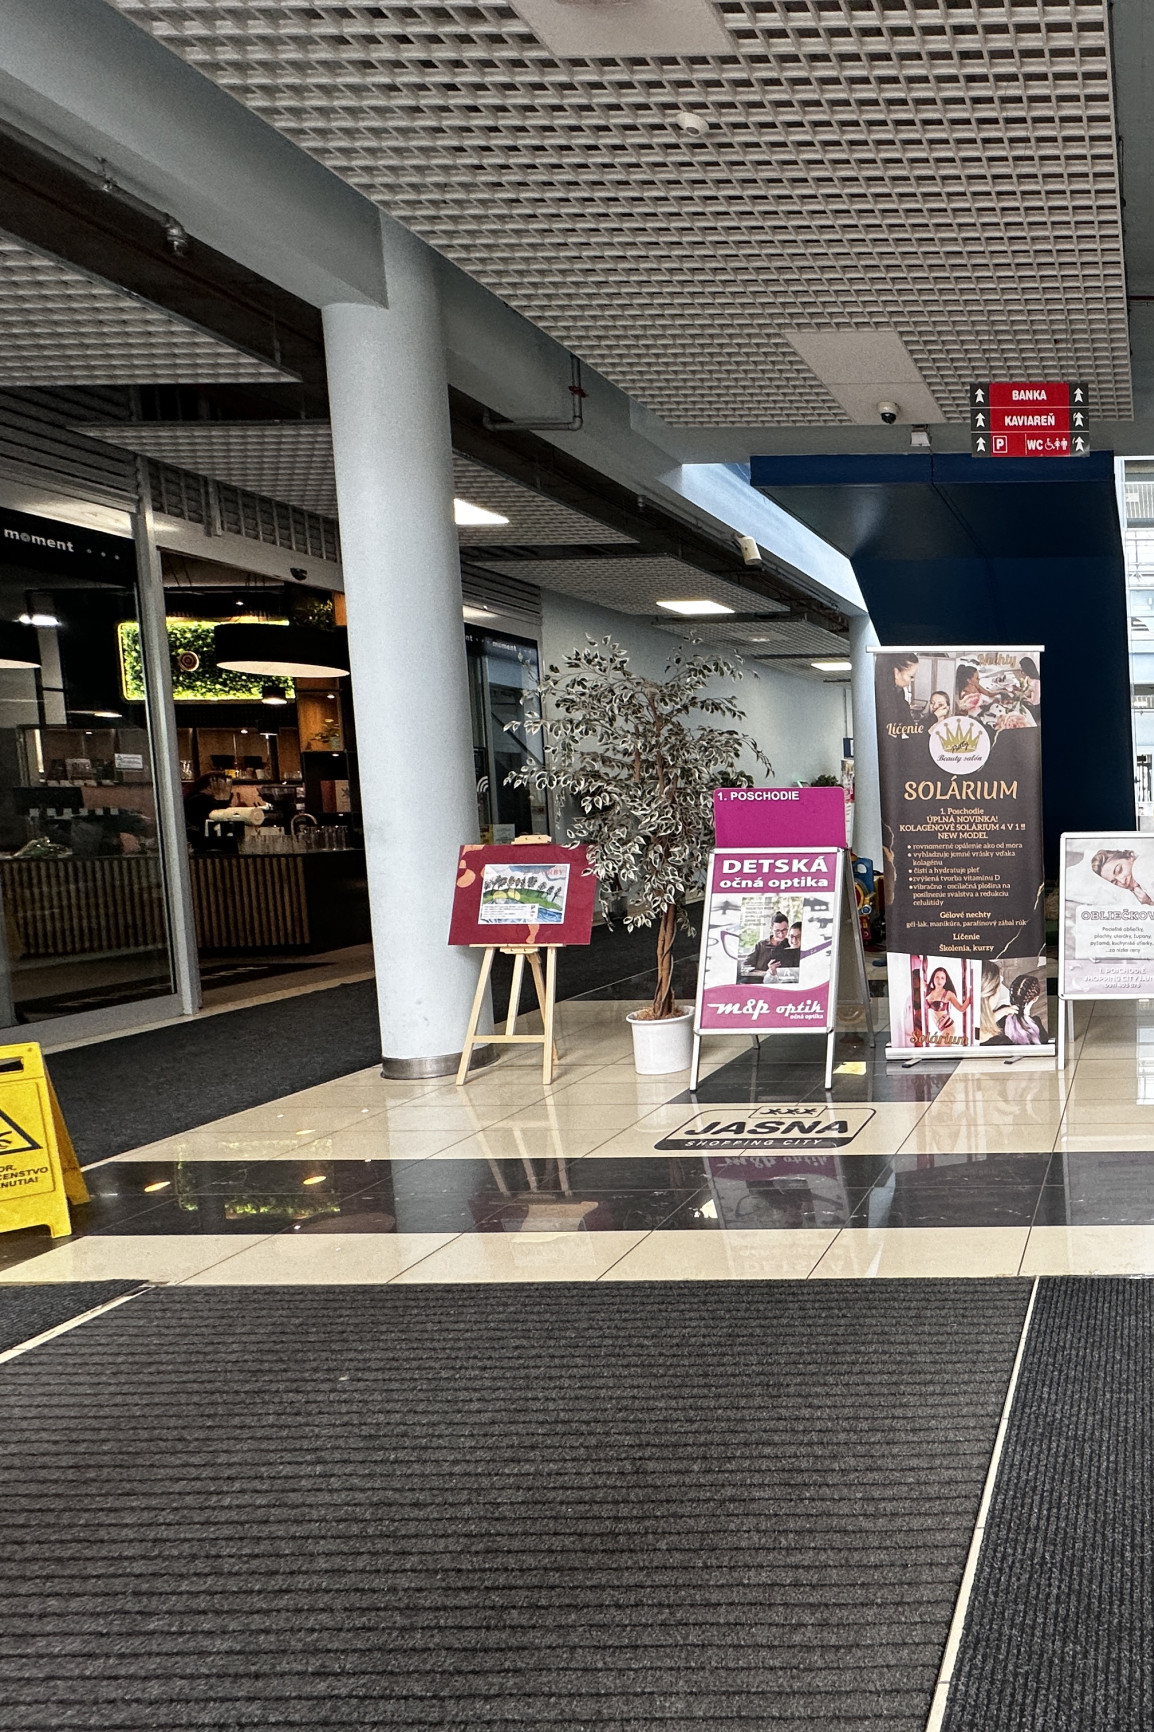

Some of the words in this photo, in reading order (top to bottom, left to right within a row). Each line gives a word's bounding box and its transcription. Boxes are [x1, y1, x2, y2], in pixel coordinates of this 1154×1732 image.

[1012, 389, 1047, 401] BANKA
[1004, 412, 1055, 427] KAVIAREŇ
[996, 438, 1004, 450] P
[1027, 439, 1043, 451] WC
[4, 528, 74, 553] moment
[886, 722, 925, 739] Líčenie
[936, 754, 962, 763] Beauty
[904, 776, 1018, 800] SOLÁRIUM
[717, 792, 727, 801] 1.
[730, 790, 800, 801] POSCHODIE
[947, 807, 984, 815] Poschodie
[926, 815, 955, 823] ÚPLNÁ
[899, 823, 955, 832] KOLAGÉNOVÉ
[956, 823, 999, 831] SOLÁRIUM
[954, 842, 982, 851] opálenie
[913, 850, 949, 859] vyhladzuje
[722, 855, 829, 874] DETSKÁ
[913, 858, 943, 867] kolagénu
[934, 867, 966, 876] hydratuje
[719, 876, 764, 889] očná
[768, 876, 829, 890] optika
[940, 911, 965, 919] Gélové
[966, 911, 991, 920] nechty
[953, 932, 980, 941] Líčenie
[939, 943, 972, 952] Školenia,
[973, 943, 995, 953] kurzy
[706, 998, 771, 1020] m&p
[775, 1000, 825, 1017] optik
[909, 1030, 969, 1046] Solárium
[684, 1120, 849, 1136] JASNA
[684, 1138, 774, 1147] SHOPPING
[783, 1138, 823, 1146] CITY
[0, 1176, 39, 1188] NUTIA!
